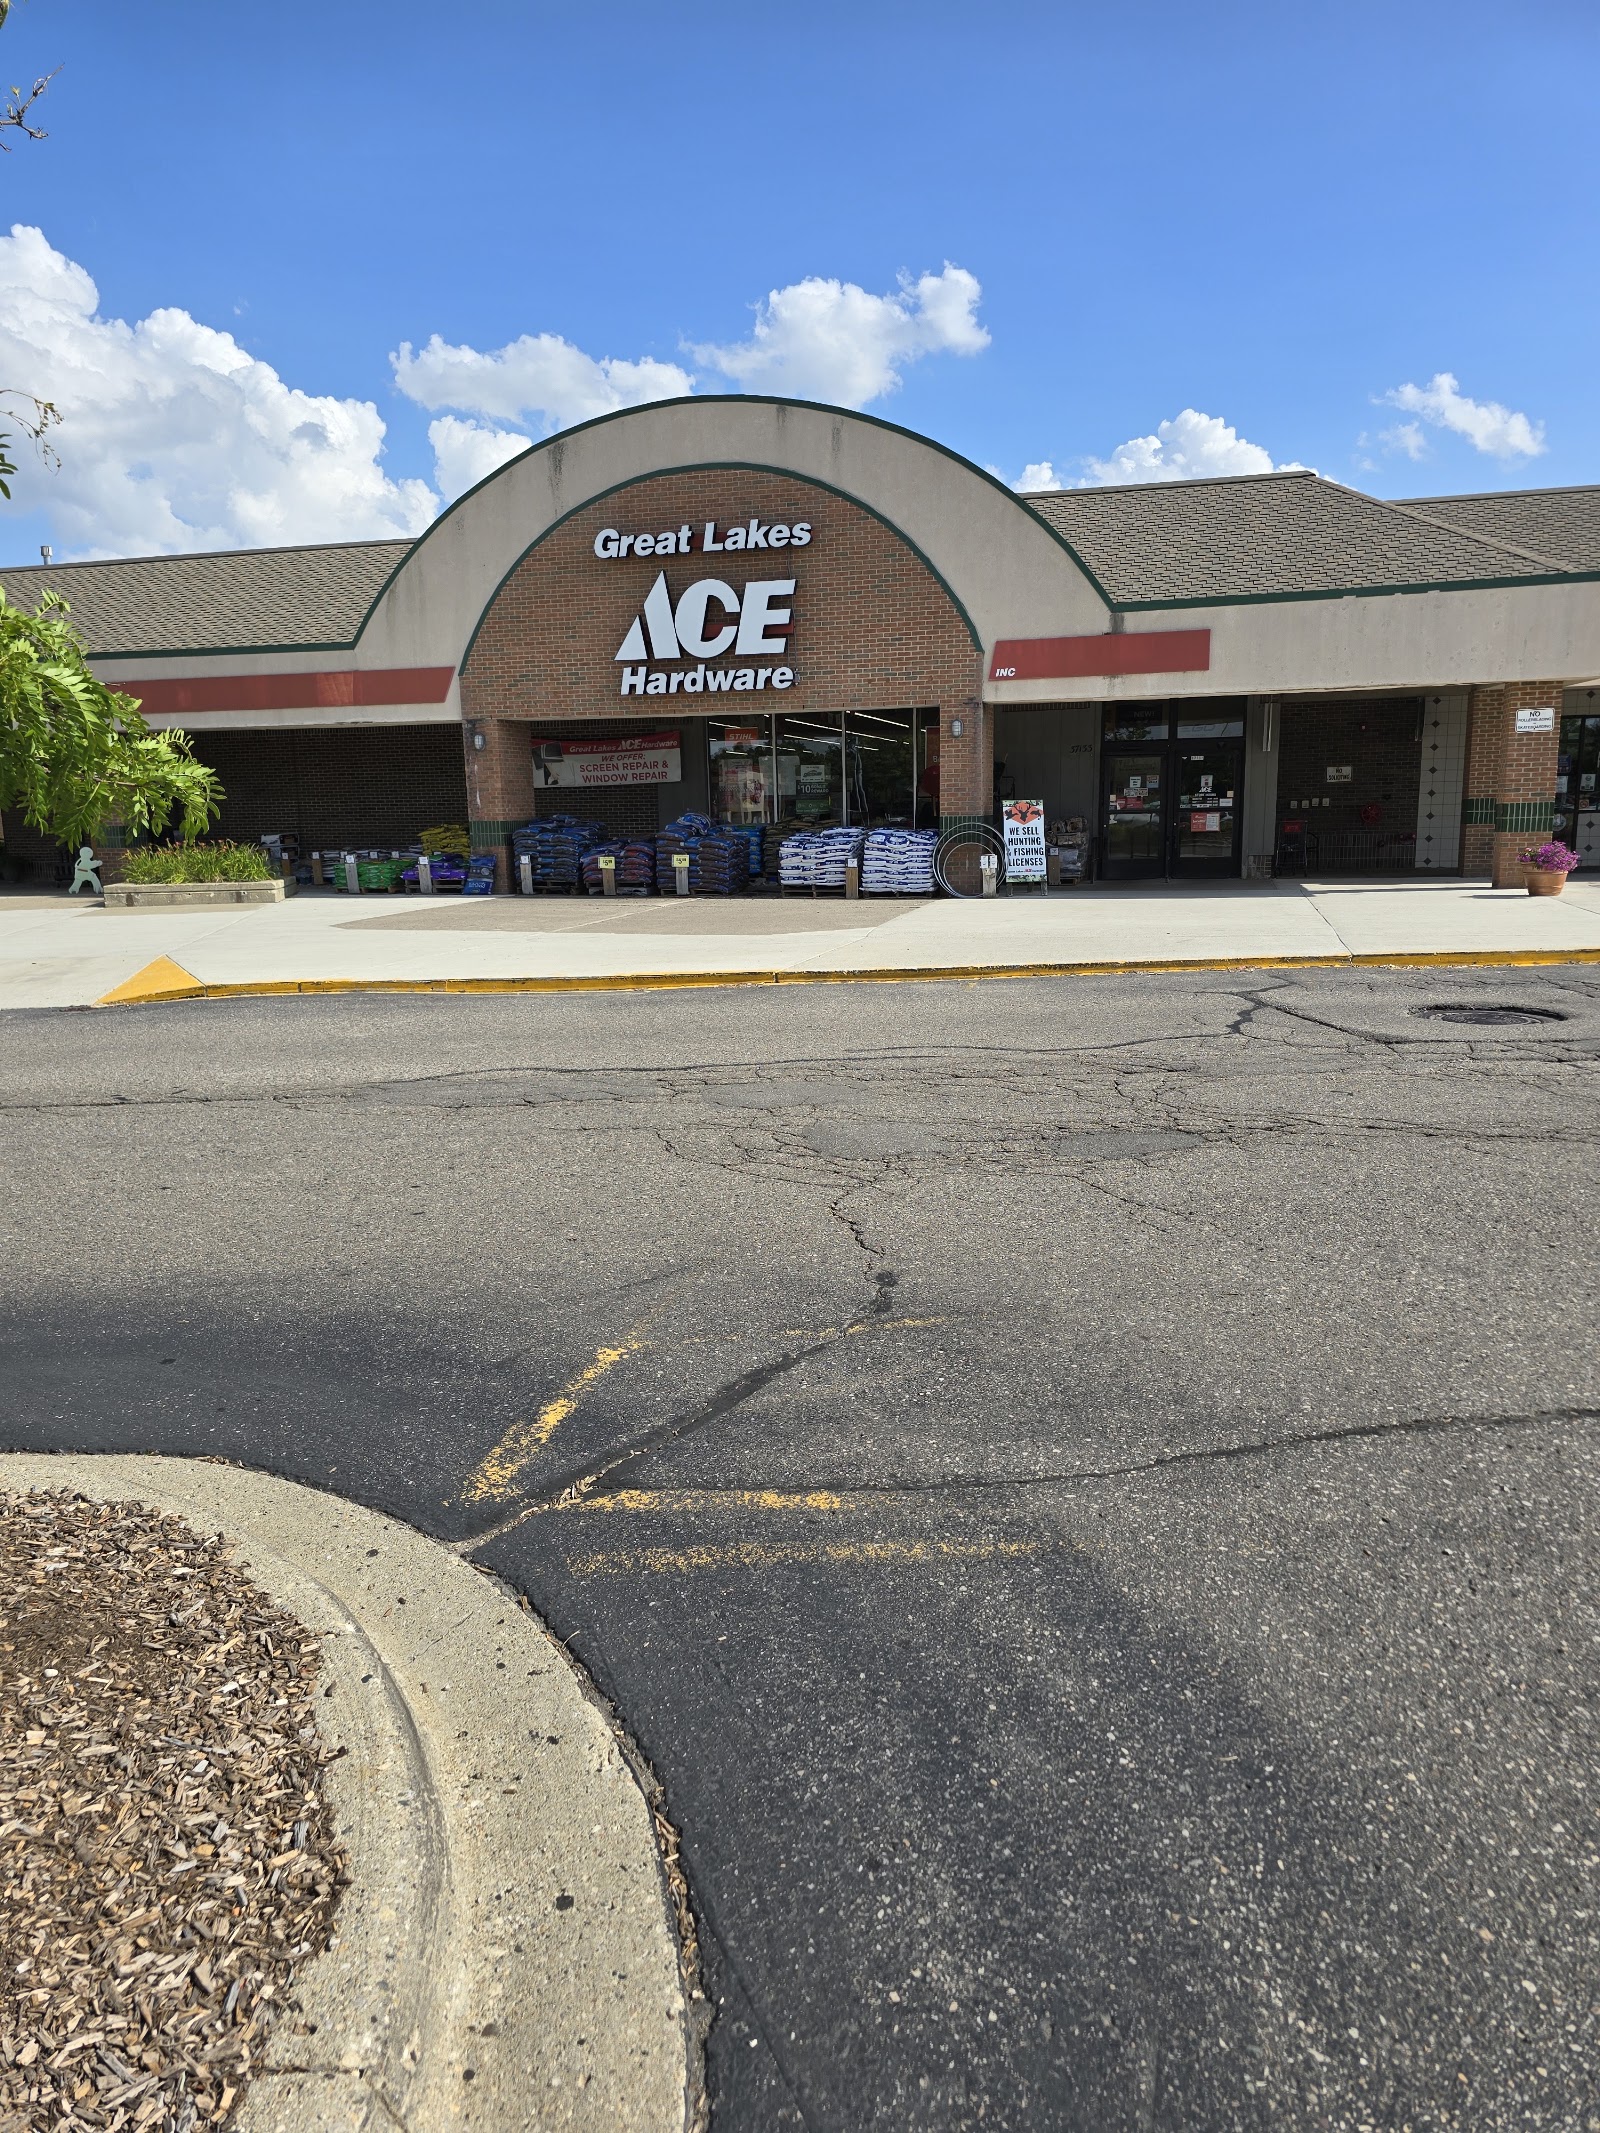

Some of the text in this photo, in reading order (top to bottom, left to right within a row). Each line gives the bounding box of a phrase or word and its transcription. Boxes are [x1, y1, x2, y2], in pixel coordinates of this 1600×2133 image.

[594, 519, 812, 558] Great Lakes
[614, 570, 797, 661] ACE
[995, 667, 1016, 677] INC
[621, 664, 794, 695] Hardware
[569, 739, 678, 753] Great Lakes ACE Hardware
[617, 753, 646, 761] OFFER:
[579, 760, 669, 773] SCREEN REPAIR &
[581, 771, 668, 783] WINDOW REPAIR
[1009, 826, 1040, 836] WE SELL
[1008, 837, 1041, 846] HUNTING
[1014, 847, 1044, 856] FISHING
[1008, 857, 1043, 867] LICENSES
